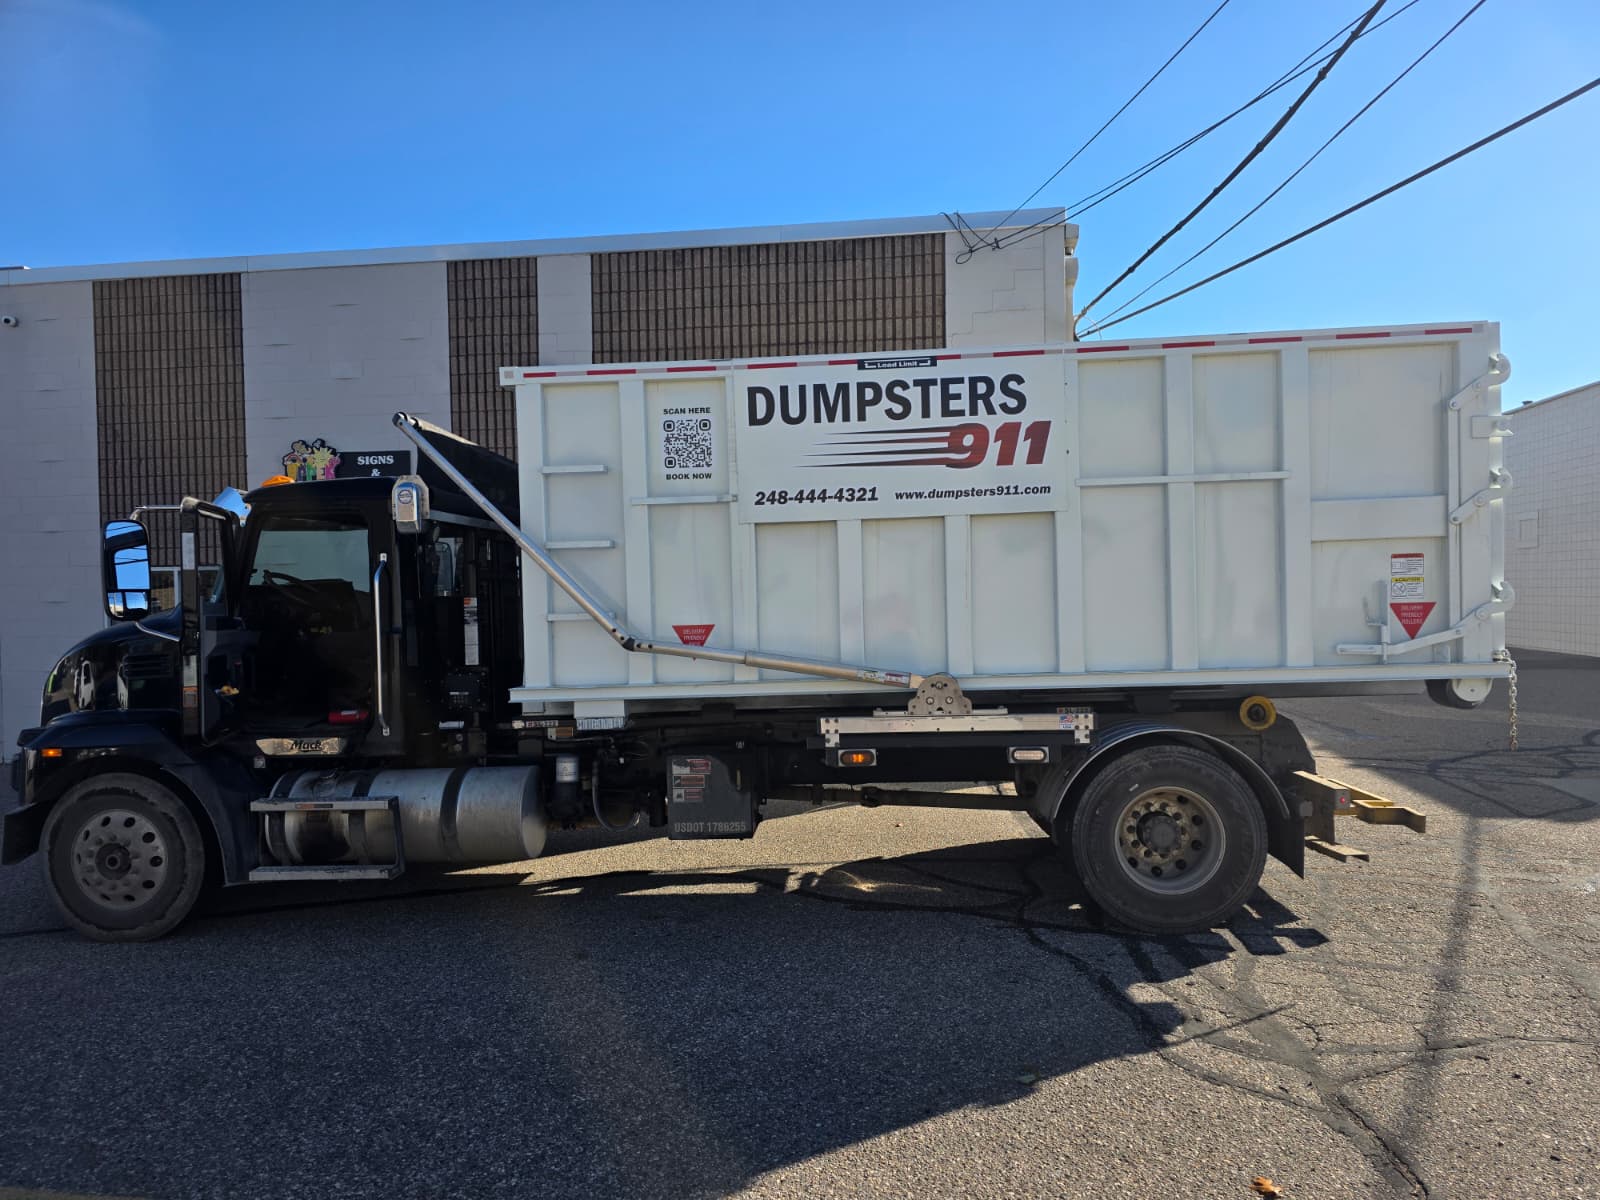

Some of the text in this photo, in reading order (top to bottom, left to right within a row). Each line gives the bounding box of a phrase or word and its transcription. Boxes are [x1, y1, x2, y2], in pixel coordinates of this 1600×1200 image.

[747, 373, 1027, 427] DUMPSTERS
[663, 406, 711, 415] SCAN HERE
[946, 420, 1052, 470] 911
[357, 455, 395, 465] SIGNS
[371, 468, 381, 477] &
[665, 472, 713, 481] BOOK NOW
[754, 486, 879, 506] 248-444-4321
[895, 485, 1051, 501] www.dumpsters911.com
[290, 740, 322, 753] Mack
[674, 822, 705, 833] USDOT
